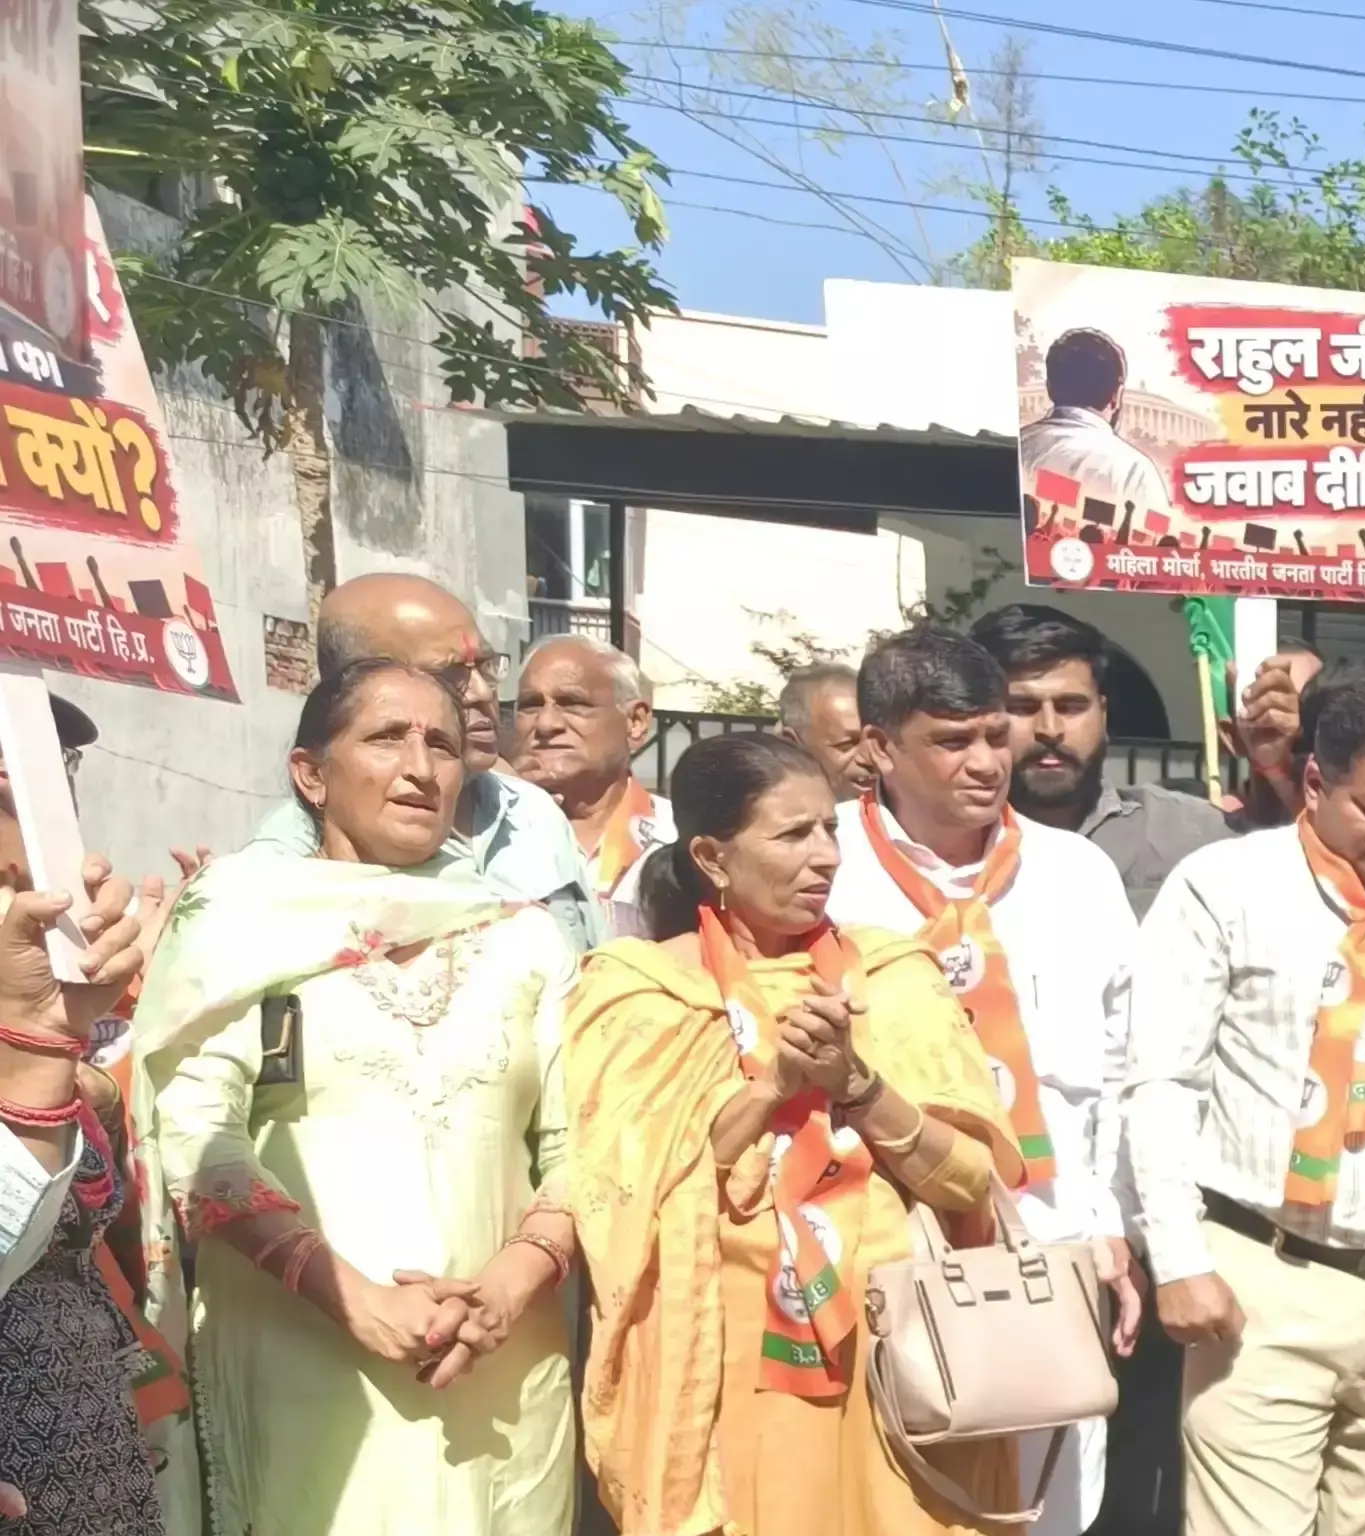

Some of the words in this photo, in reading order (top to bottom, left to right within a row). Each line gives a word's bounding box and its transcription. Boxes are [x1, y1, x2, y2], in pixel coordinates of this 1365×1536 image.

[1187, 327, 1322, 397] राहुल
[1243, 388, 1311, 440] नारे
[3, 397, 162, 532] क्यों?
[1183, 459, 1308, 508] जवाब
[1105, 548, 1158, 578] महिला
[1210, 554, 1268, 581] भारतीय
[1272, 564, 1316, 584] जनता
[1320, 559, 1354, 587] पार्टी
[7, 602, 62, 644] जनता
[64, 609, 106, 654] पार्टी
